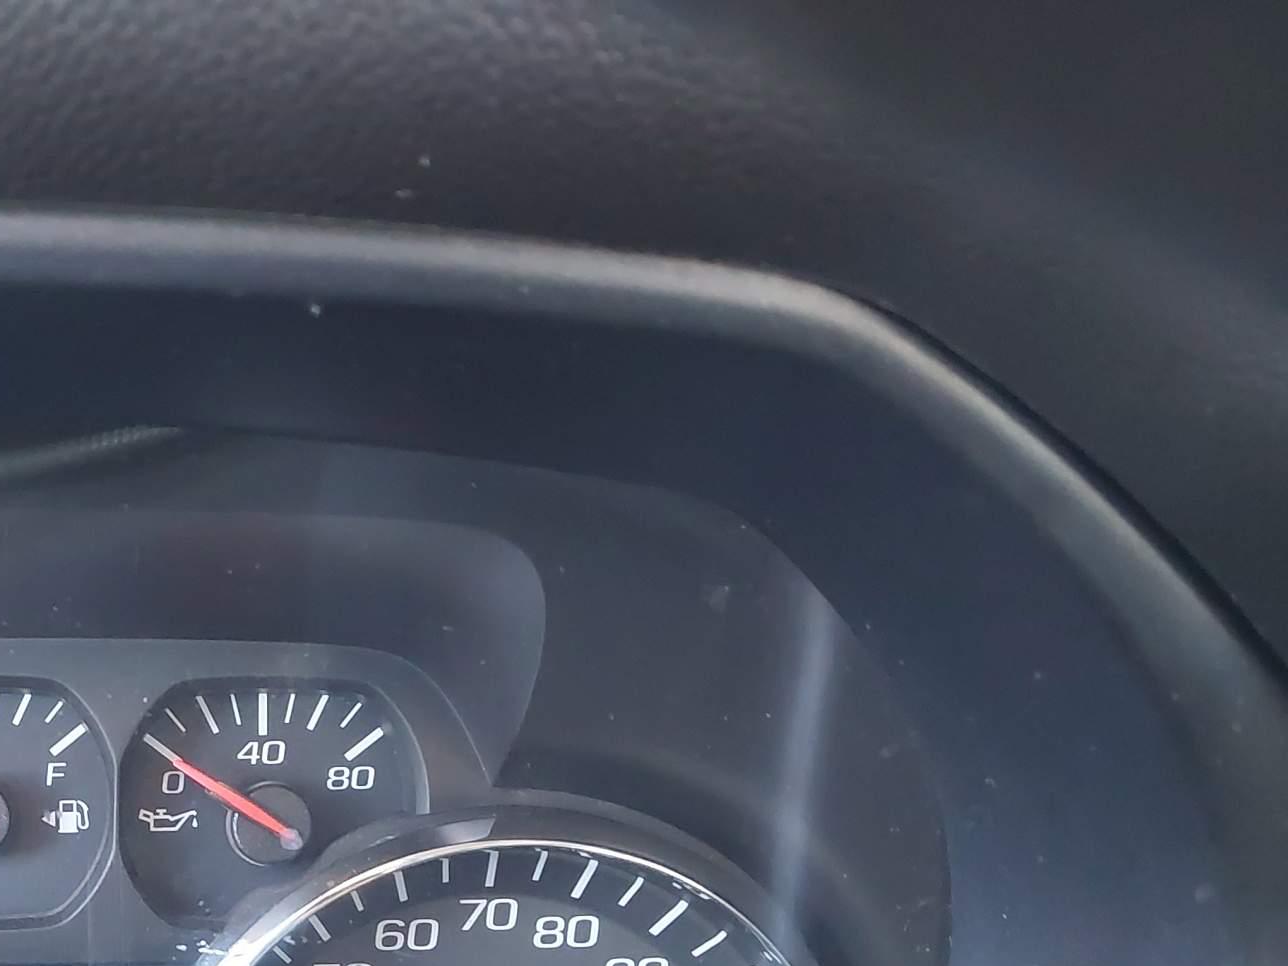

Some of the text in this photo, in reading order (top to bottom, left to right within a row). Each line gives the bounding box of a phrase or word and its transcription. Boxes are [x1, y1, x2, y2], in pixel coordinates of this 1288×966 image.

[236, 740, 286, 765] 40
[46, 762, 67, 786] F
[161, 769, 186, 794] 0
[326, 766, 375, 790] 80
[459, 898, 519, 931] 70
[375, 918, 439, 951] 60
[533, 915, 600, 949] 80
